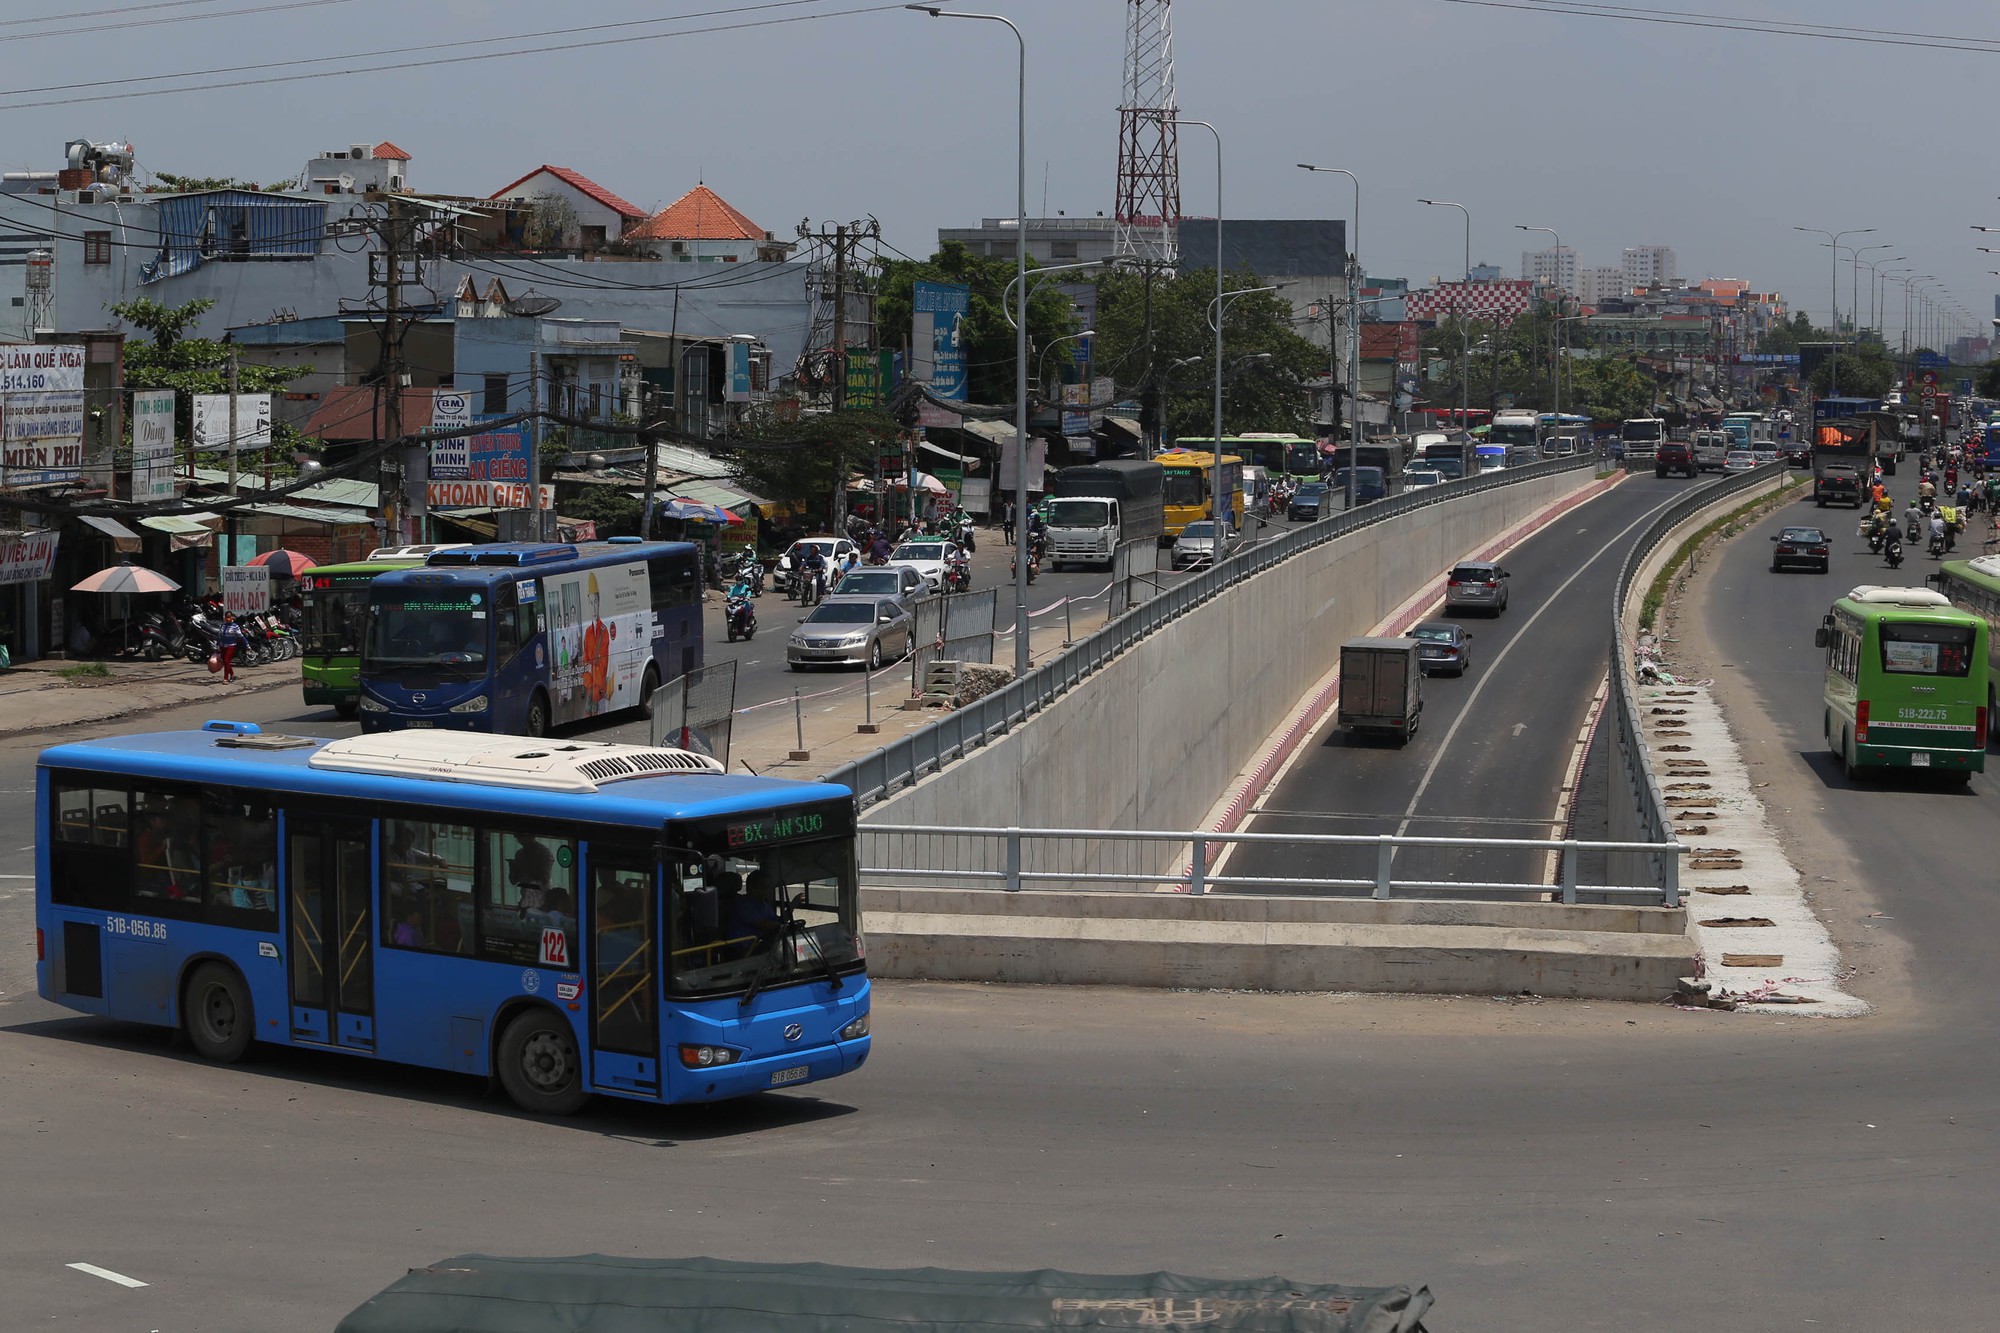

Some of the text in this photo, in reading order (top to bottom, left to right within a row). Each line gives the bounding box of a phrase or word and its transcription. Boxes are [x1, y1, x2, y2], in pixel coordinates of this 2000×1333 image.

[7, 348, 31, 369] LÀM
[59, 352, 82, 368] NGA
[53, 437, 81, 466] PHÍ
[495, 433, 521, 452] TRUNG
[435, 453, 466, 465] MINH
[489, 451, 528, 480] GIẾNG
[427, 481, 548, 509] KHOAN GIẾNG
[315, 577, 331, 588] 41
[628, 567, 646, 577] Panasonic
[227, 583, 267, 610] NHÀ ĐẤT
[1898, 708, 1948, 720] 51B-222.75
[773, 818, 792, 838] AN
[106, 916, 167, 940] 51B-056.86
[542, 930, 566, 963] 122
